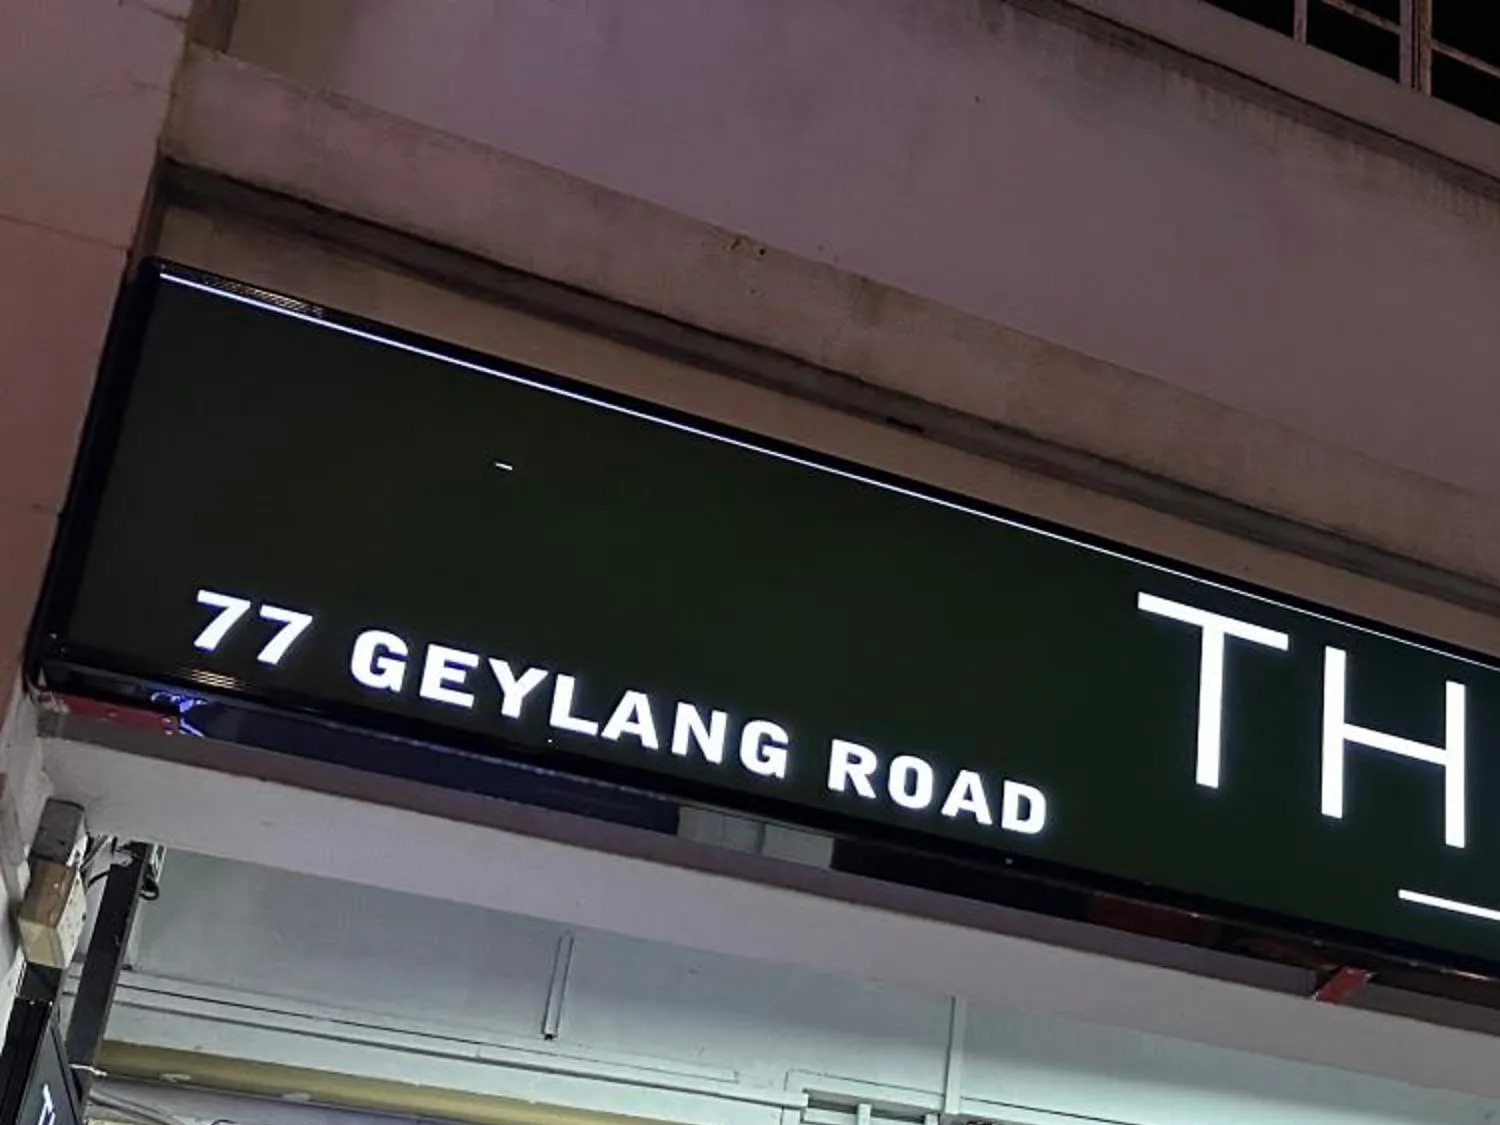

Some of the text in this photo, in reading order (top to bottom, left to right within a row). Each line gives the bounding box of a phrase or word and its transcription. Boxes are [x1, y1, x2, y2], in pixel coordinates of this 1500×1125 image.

[194, 589, 1047, 835] 77 GEYLANG ROAD
